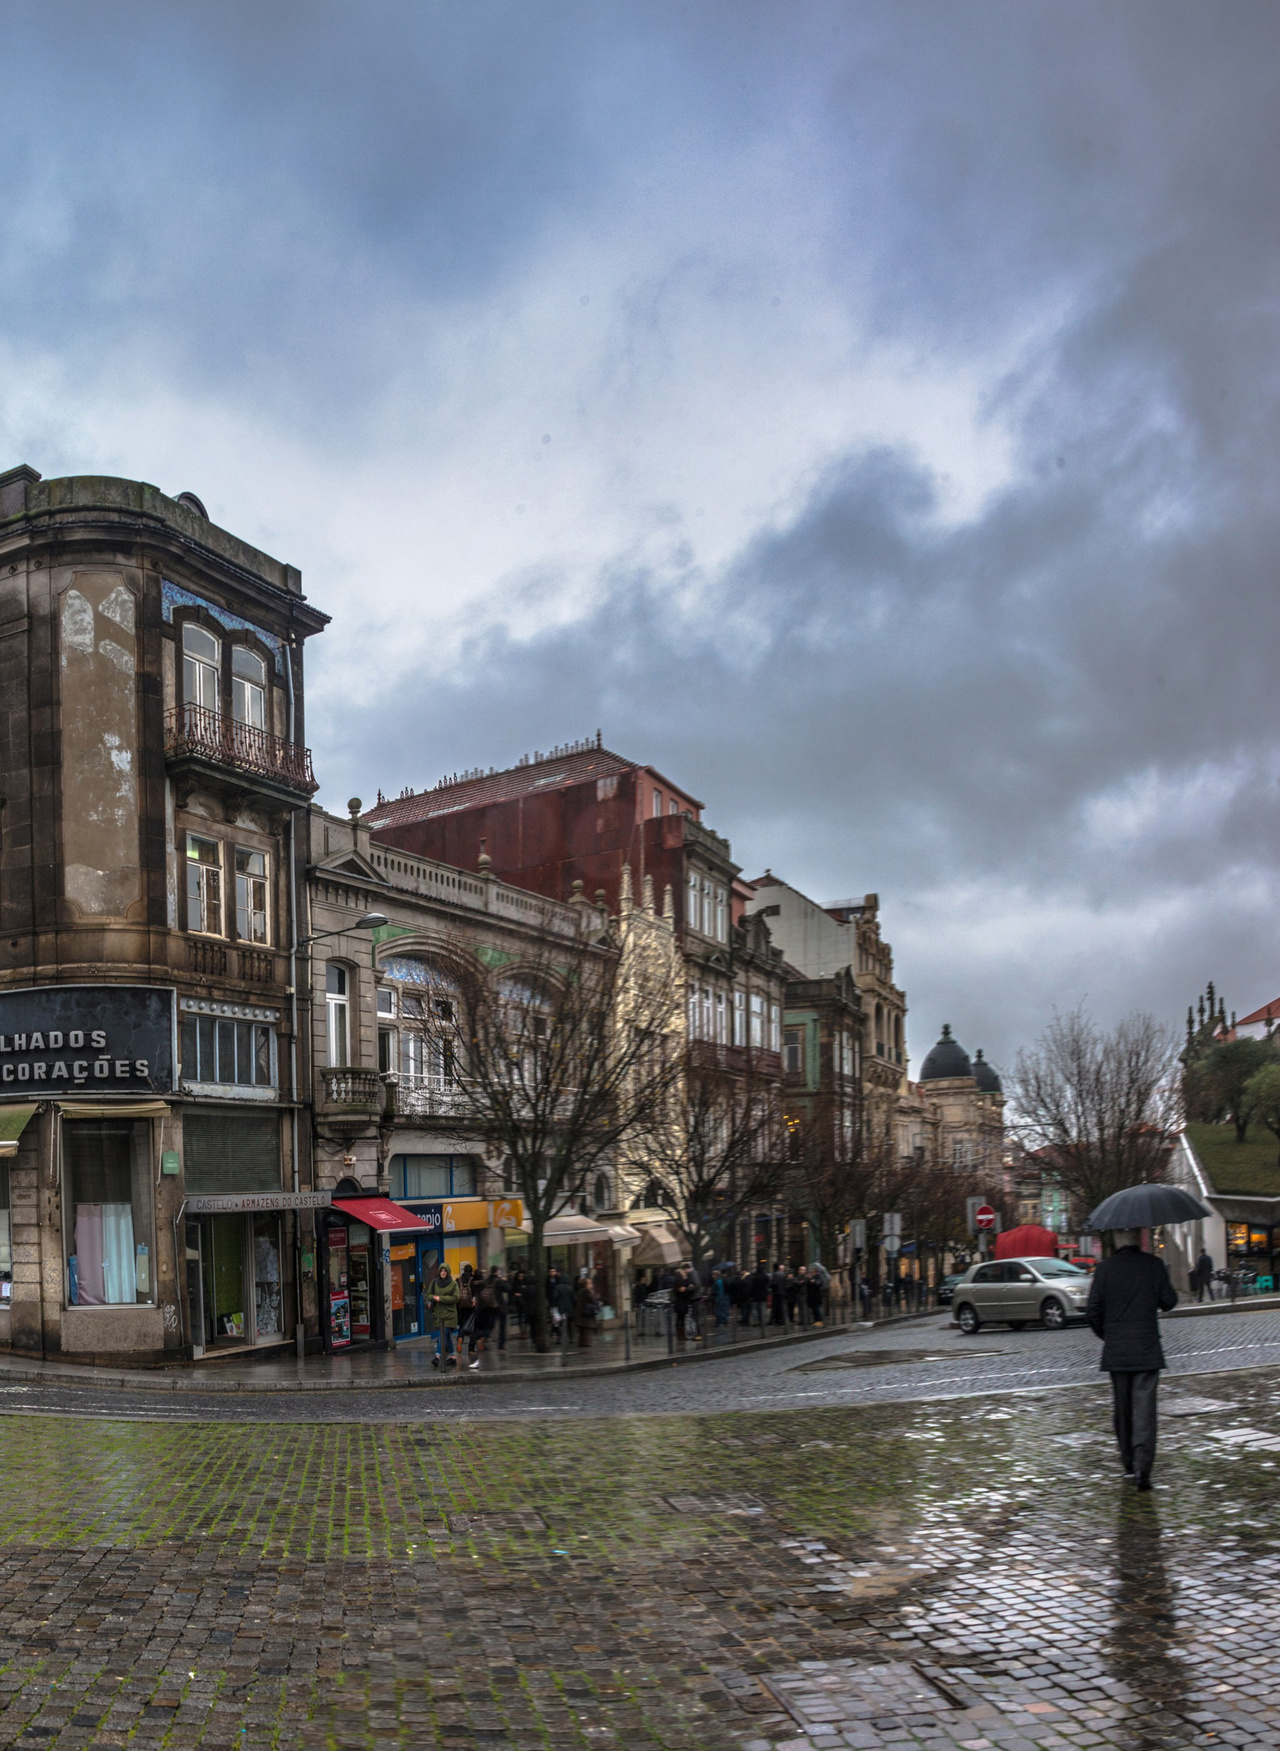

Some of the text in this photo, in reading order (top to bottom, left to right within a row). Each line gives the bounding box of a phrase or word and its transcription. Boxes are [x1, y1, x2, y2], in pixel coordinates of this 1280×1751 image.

[196, 1195, 326, 1210] CASTELO ARMAZENS DO CASTELO
